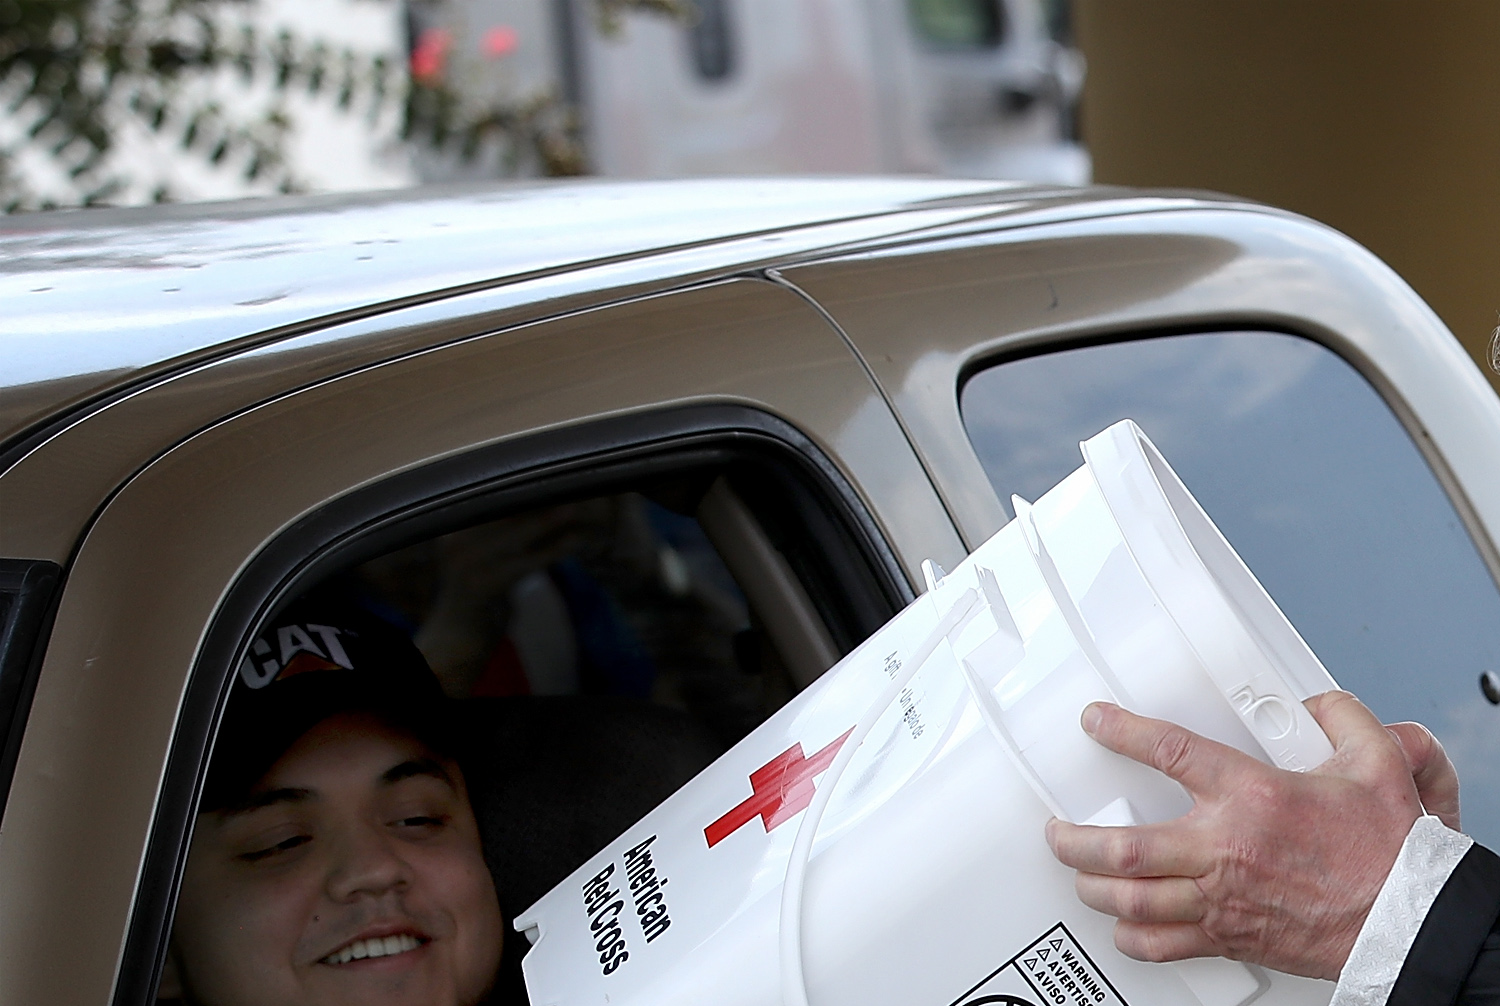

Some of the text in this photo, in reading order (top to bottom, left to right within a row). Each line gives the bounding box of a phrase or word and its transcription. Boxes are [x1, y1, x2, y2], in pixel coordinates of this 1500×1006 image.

[239, 623, 354, 690] CAT
[883, 658, 903, 678] gift
[898, 687, 915, 710] Un
[901, 702, 923, 731] regalo
[624, 834, 671, 944] American
[582, 862, 629, 976] Red Cross
[1034, 970, 1066, 1005] AVISO
[1061, 949, 1106, 1003] WARNING
